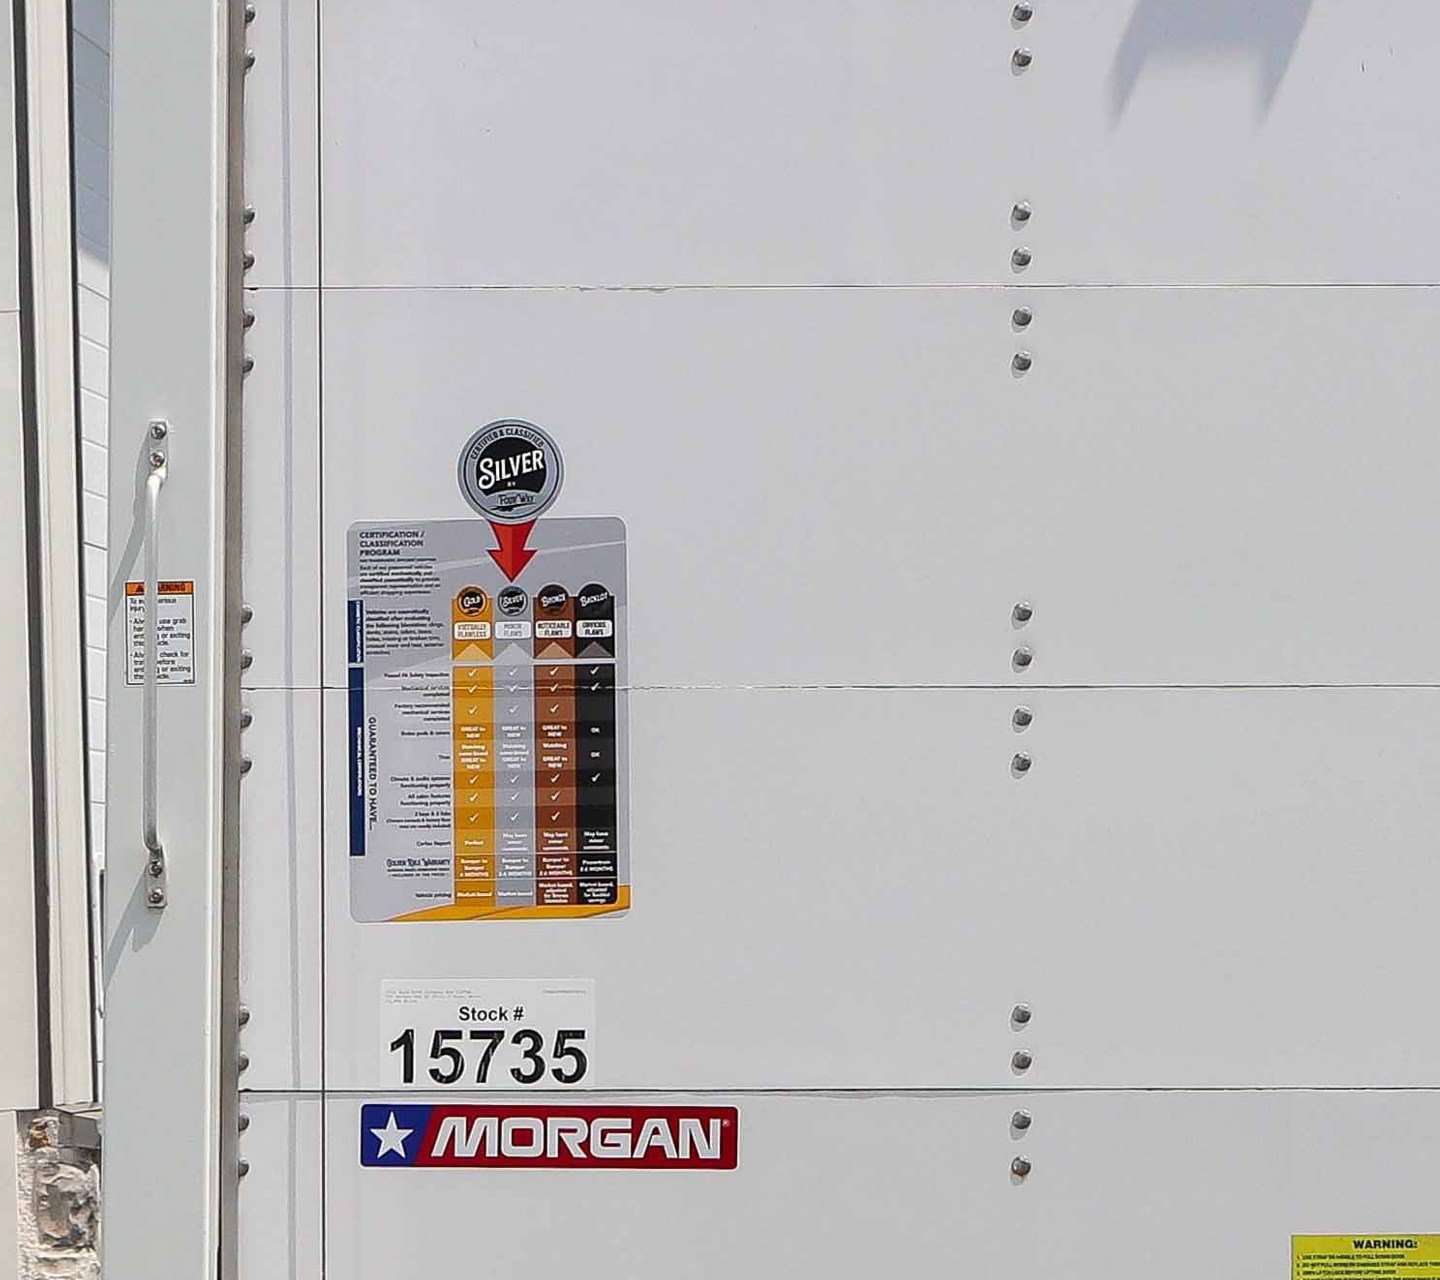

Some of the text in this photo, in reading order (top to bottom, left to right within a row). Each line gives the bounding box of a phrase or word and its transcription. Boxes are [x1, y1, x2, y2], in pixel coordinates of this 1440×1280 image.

[478, 450, 544, 490] SILVER
[359, 531, 419, 539] CERTIFICATION
[359, 540, 424, 548] CLASSIFICATION
[368, 717, 376, 780] GUARANTEED
[369, 784, 376, 795] TO
[459, 1006, 524, 1021] Stock #
[390, 1028, 588, 1084] 15735
[430, 1116, 722, 1159] MORGAN
[1353, 1240, 1418, 1248] WARNING:
